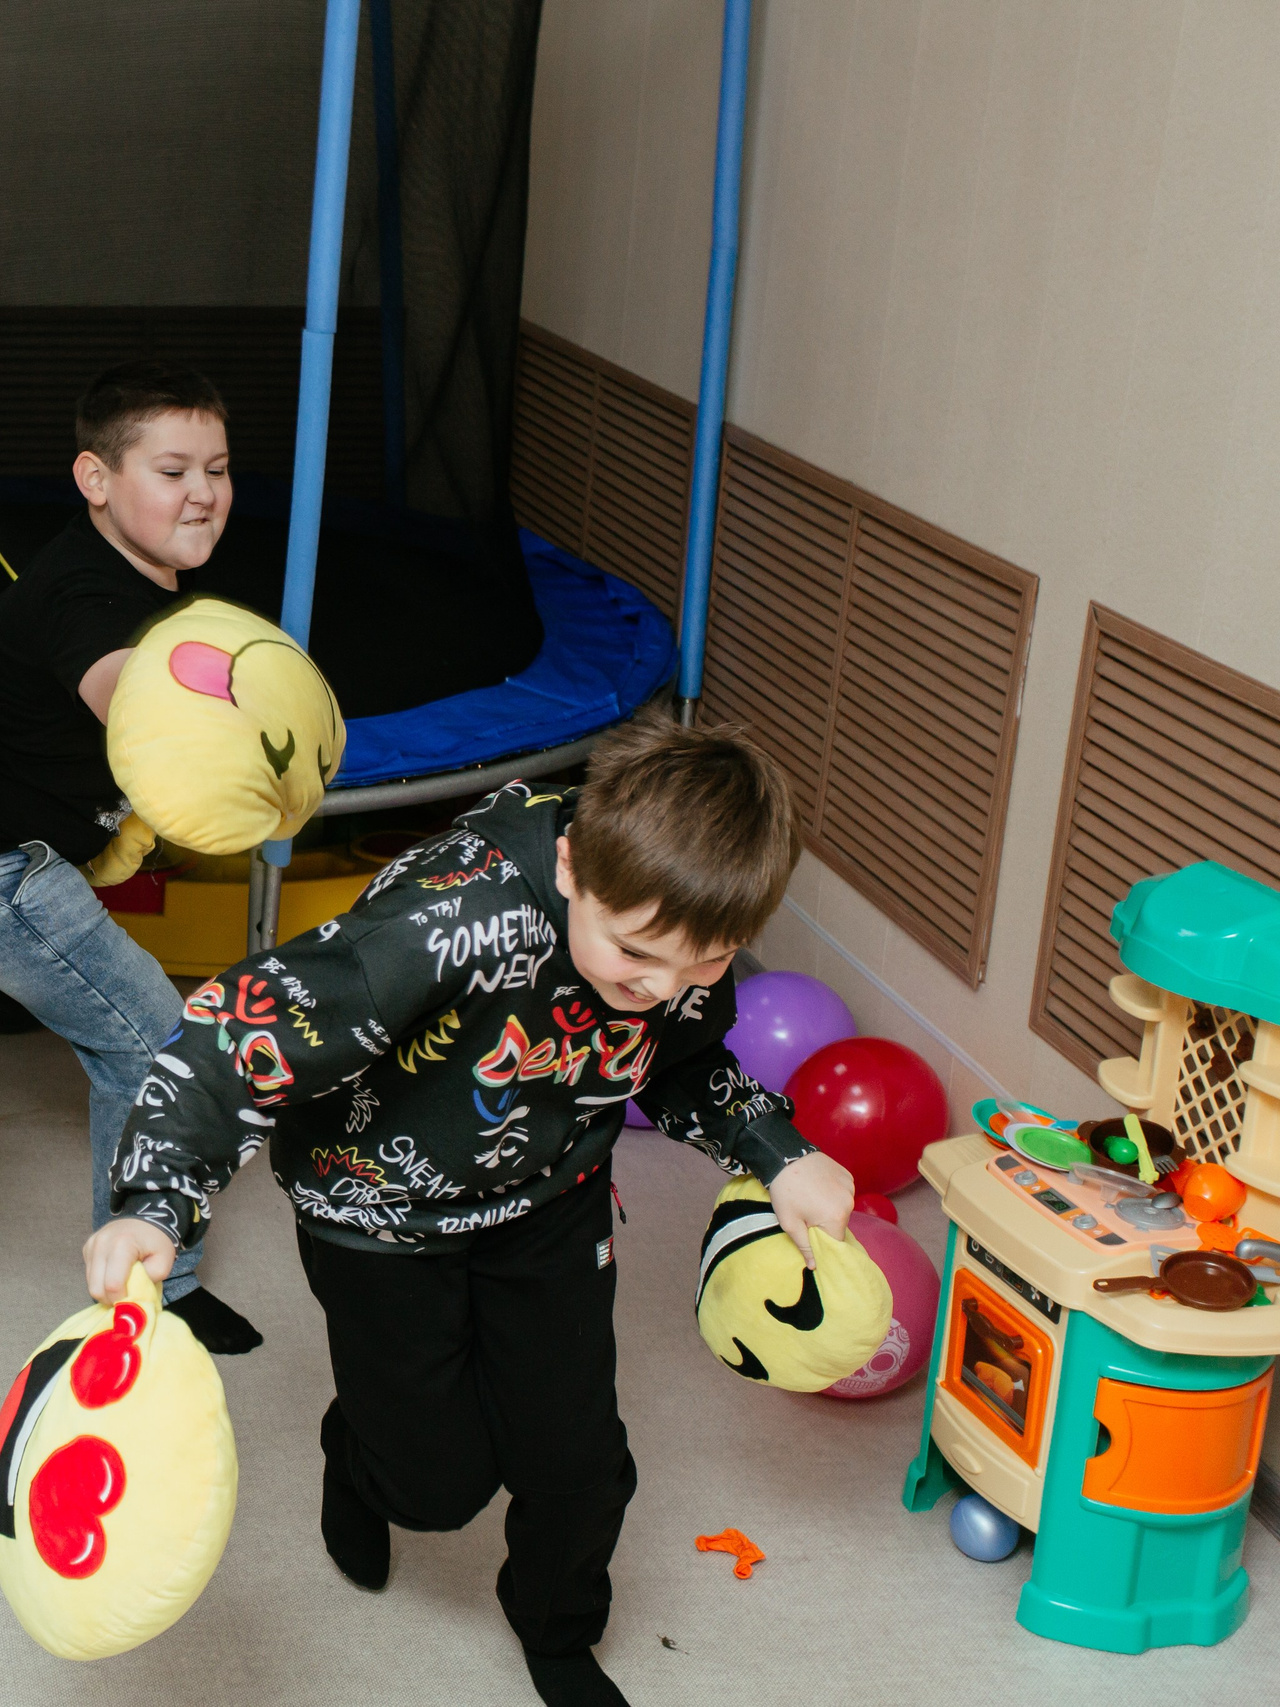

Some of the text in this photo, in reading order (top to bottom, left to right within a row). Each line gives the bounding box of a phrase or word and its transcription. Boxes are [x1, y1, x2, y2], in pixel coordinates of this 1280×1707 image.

[427, 896, 463, 919] TRY
[428, 903, 558, 983] SOMETHIN
[258, 956, 287, 975] BE
[550, 985, 581, 1002] BE
[379, 1135, 467, 1200] SNEAK
